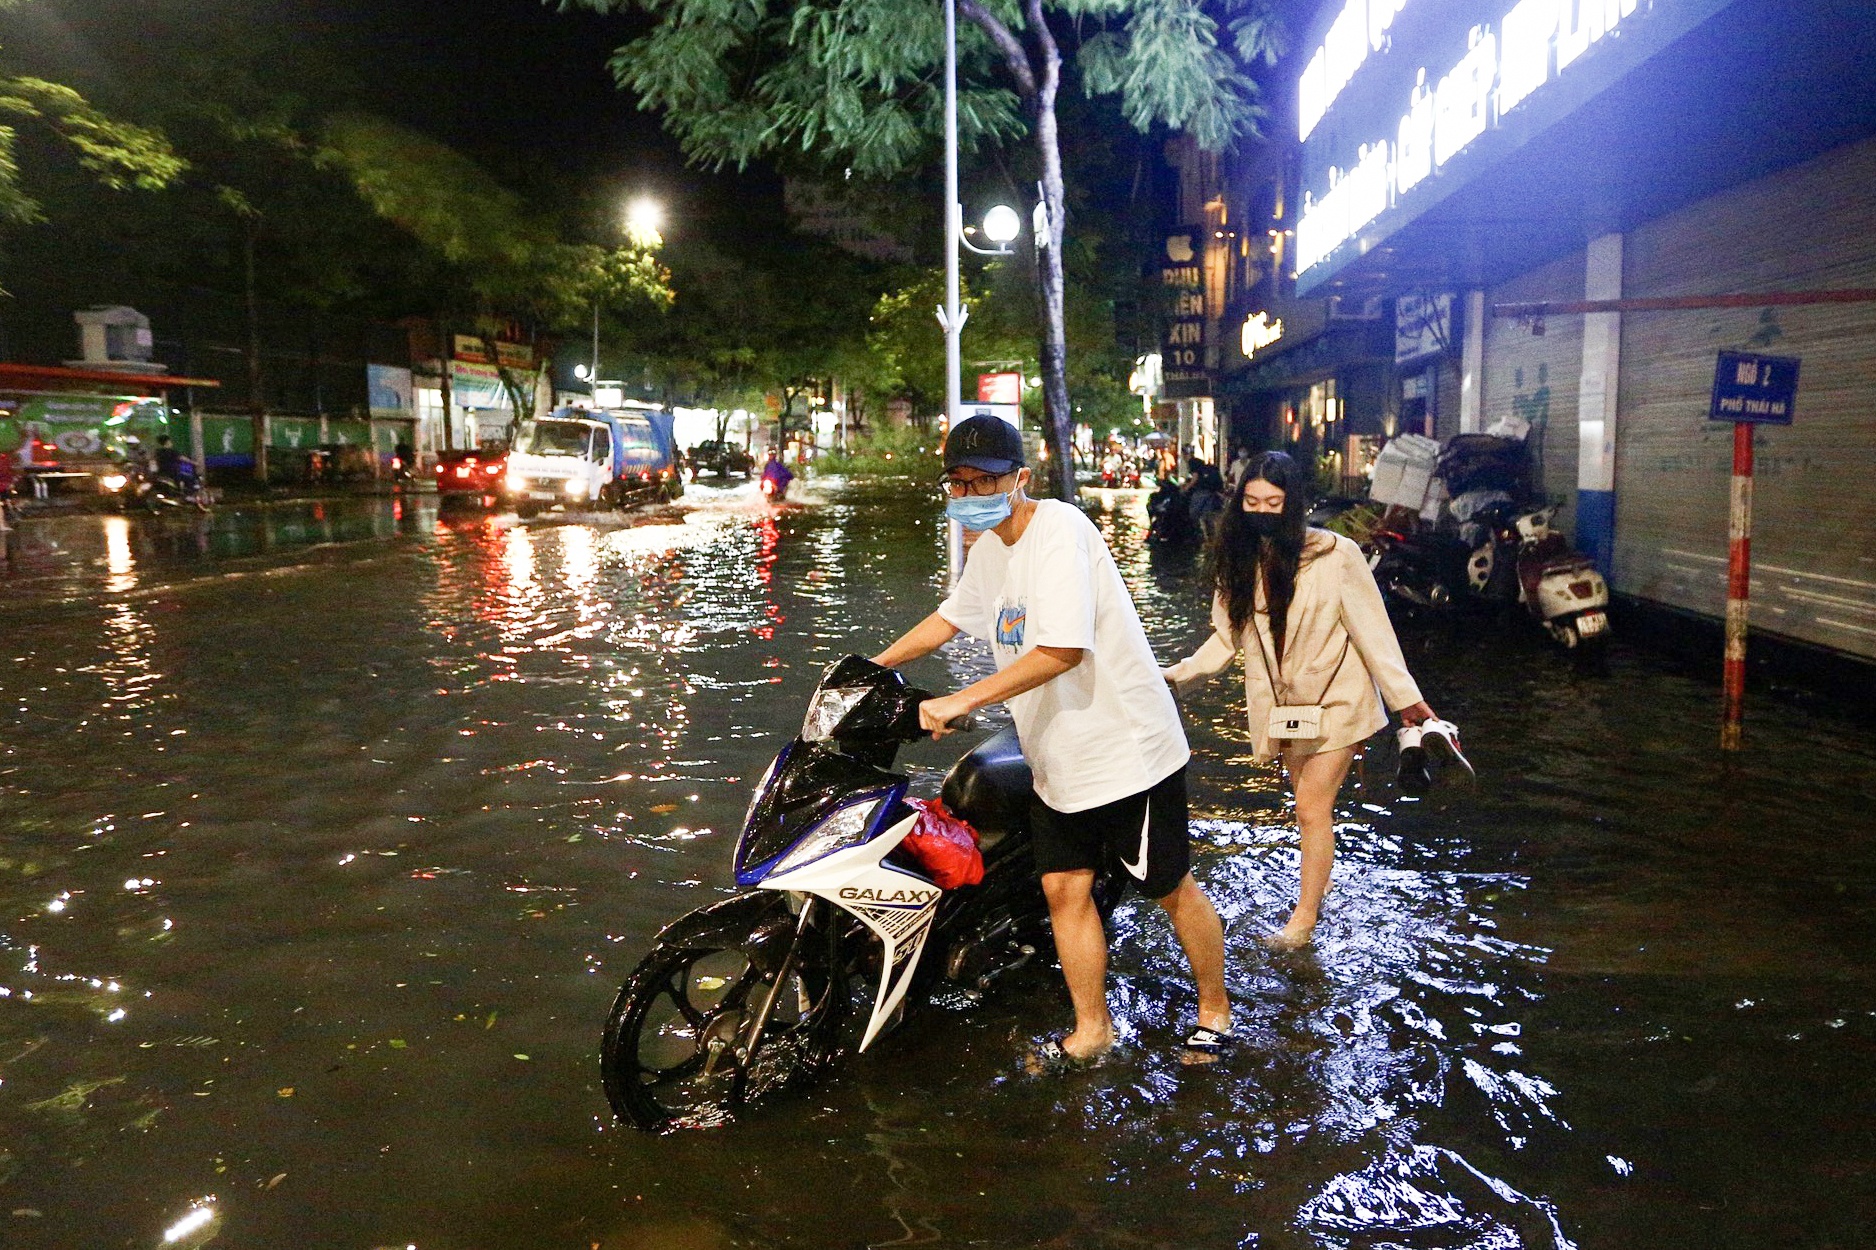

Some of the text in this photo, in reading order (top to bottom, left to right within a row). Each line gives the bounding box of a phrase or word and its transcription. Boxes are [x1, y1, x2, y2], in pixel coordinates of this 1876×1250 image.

[1173, 350, 1196, 366] 10
[1762, 364, 1771, 387] 2
[1720, 395, 1744, 411] PHỐ
[1745, 398, 1770, 414] THÁI
[838, 887, 940, 903] GALAXY
[1193, 1030, 1219, 1042] NIKE
